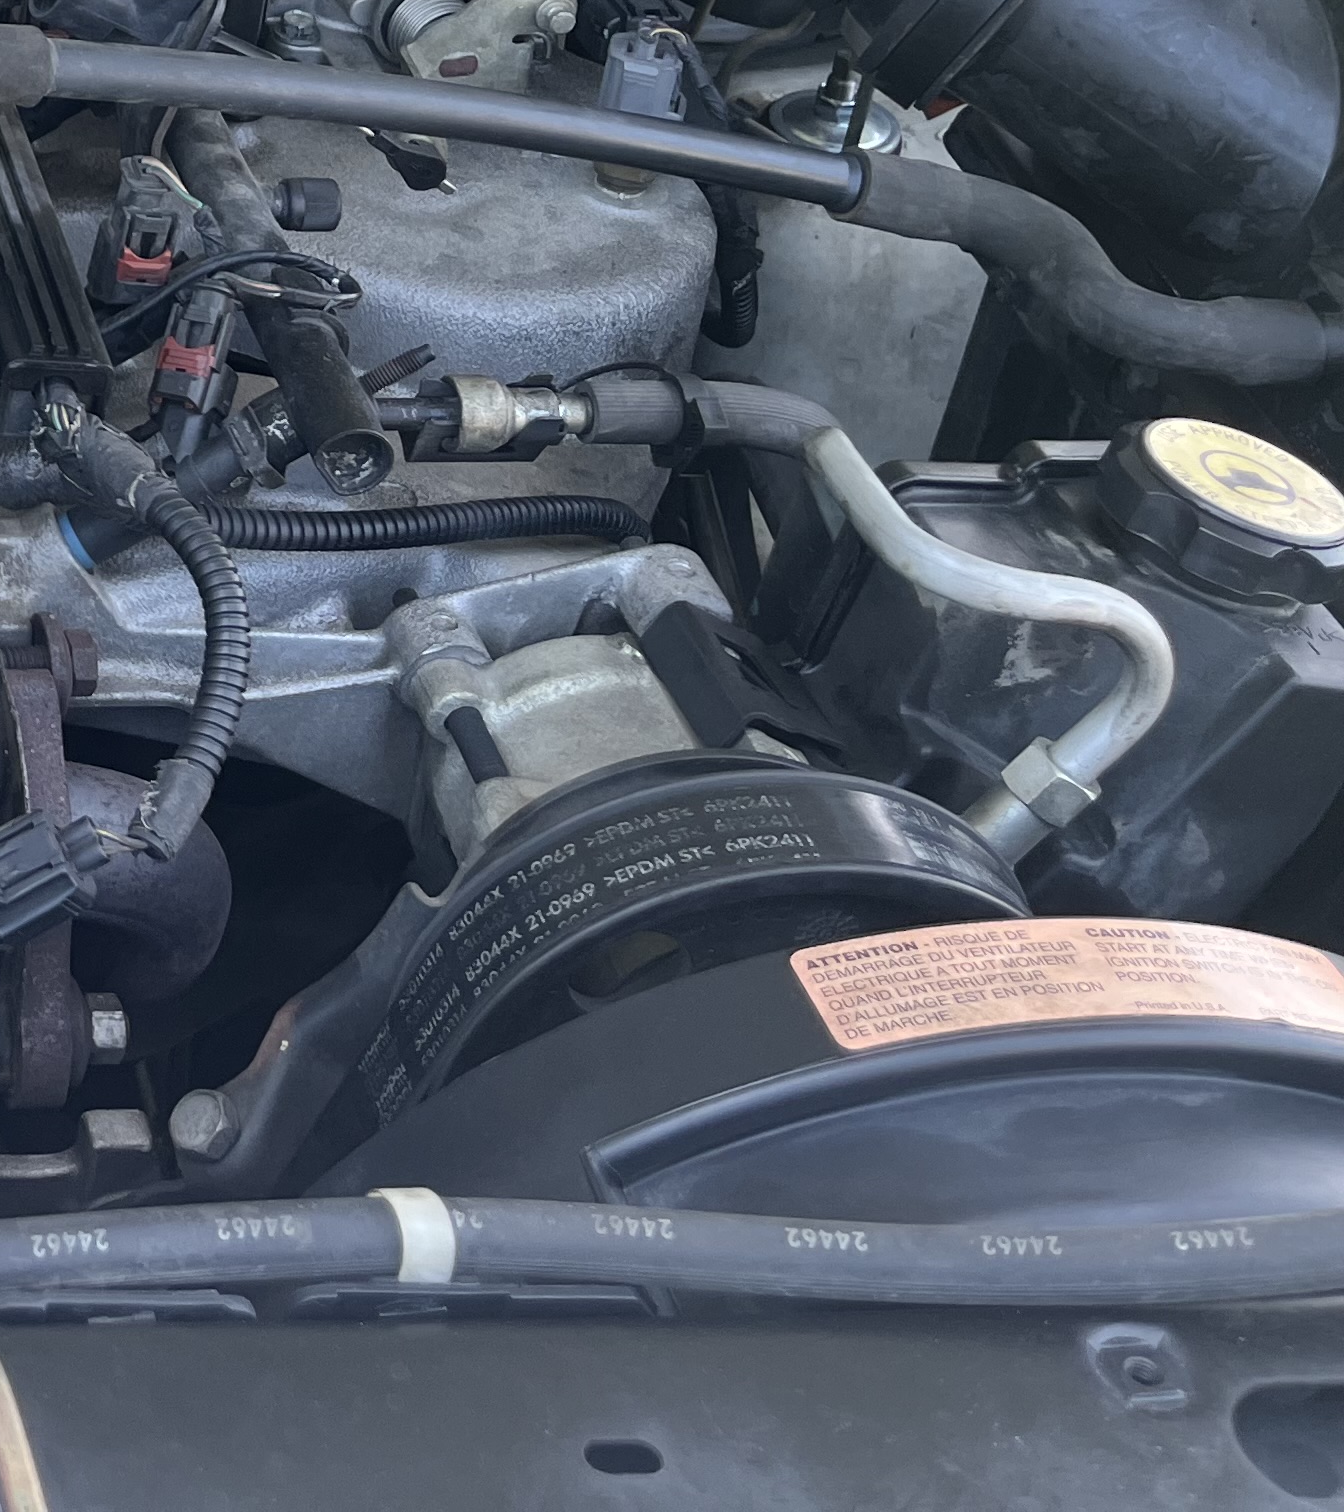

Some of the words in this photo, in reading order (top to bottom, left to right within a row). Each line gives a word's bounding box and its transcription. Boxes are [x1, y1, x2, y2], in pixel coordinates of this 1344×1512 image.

[1187, 423, 1290, 464] APPROVED
[602, 853, 677, 887] >EPDM
[1085, 927, 1171, 940] CAUTION
[806, 941, 919, 970] ATTENTION
[934, 931, 1001, 948] RISQUE
[1004, 928, 1029, 941] DE
[812, 954, 924, 984] DEMARRAGE
[928, 949, 955, 963] DU
[959, 940, 1077, 959] VENTILATEUR
[1094, 942, 1149, 955] START
[1153, 943, 1173, 955] AT
[1175, 945, 1206, 957] ANY
[1105, 956, 1180, 969] IGNITION
[820, 967, 934, 998] ELECTRIQUE
[952, 959, 997, 974] TOUT
[1000, 953, 1077, 970] MOMENT
[828, 989, 893, 1013] QUAND
[898, 969, 1047, 998] L'INTERRUPTEUR
[836, 994, 952, 1026] D'ALLUMAGE
[953, 989, 989, 1005] EST
[993, 987, 1019, 1000] EN
[1021, 980, 1105, 998] POSITION
[1134, 1000, 1178, 1012] Printed
[844, 1025, 872, 1041] DE
[215, 1213, 296, 1242] 24462
[591, 1211, 676, 1239] 24462
[785, 1225, 870, 1253] 24462
[1170, 1225, 1255, 1253] 24462
[31, 1227, 110, 1259] 24462
[982, 1233, 1063, 1258] 24462
